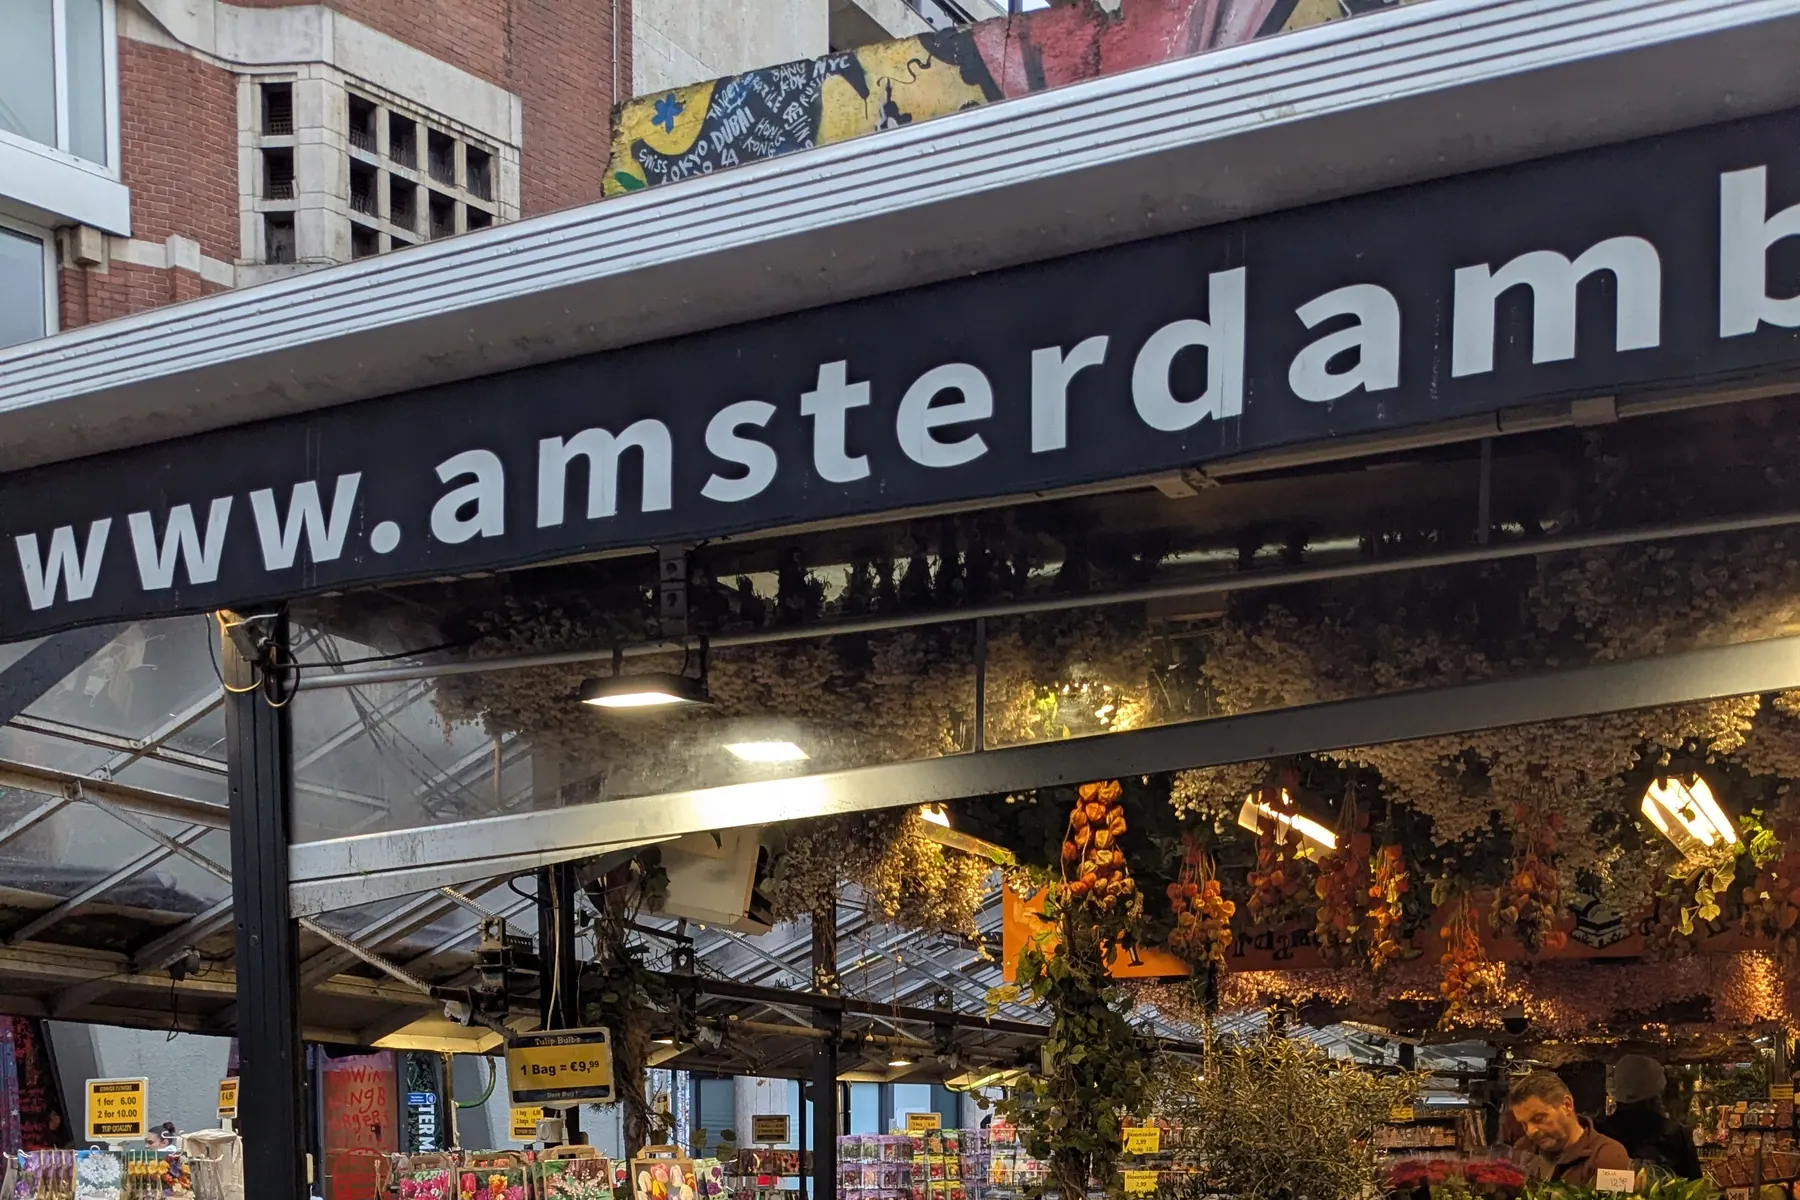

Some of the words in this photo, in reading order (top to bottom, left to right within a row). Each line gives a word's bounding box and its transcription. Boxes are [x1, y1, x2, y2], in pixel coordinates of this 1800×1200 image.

[812, 55, 850, 78] NYC
[710, 106, 755, 153] DUBAI
[535, 1038, 556, 1046] Tulip
[557, 1036, 581, 1044] Bulbs
[520, 1065, 527, 1075] 1
[532, 1064, 556, 1076] Bag
[97, 1098, 101, 1106] 1
[103, 1097, 115, 1106] for
[120, 1096, 137, 1105] 6.00
[97, 1110, 103, 1119] 2
[104, 1109, 115, 1118] for
[116, 1109, 138, 1118] 10.00
[101, 1125, 112, 1133] TOP
[112, 1124, 133, 1132] QUALITY
